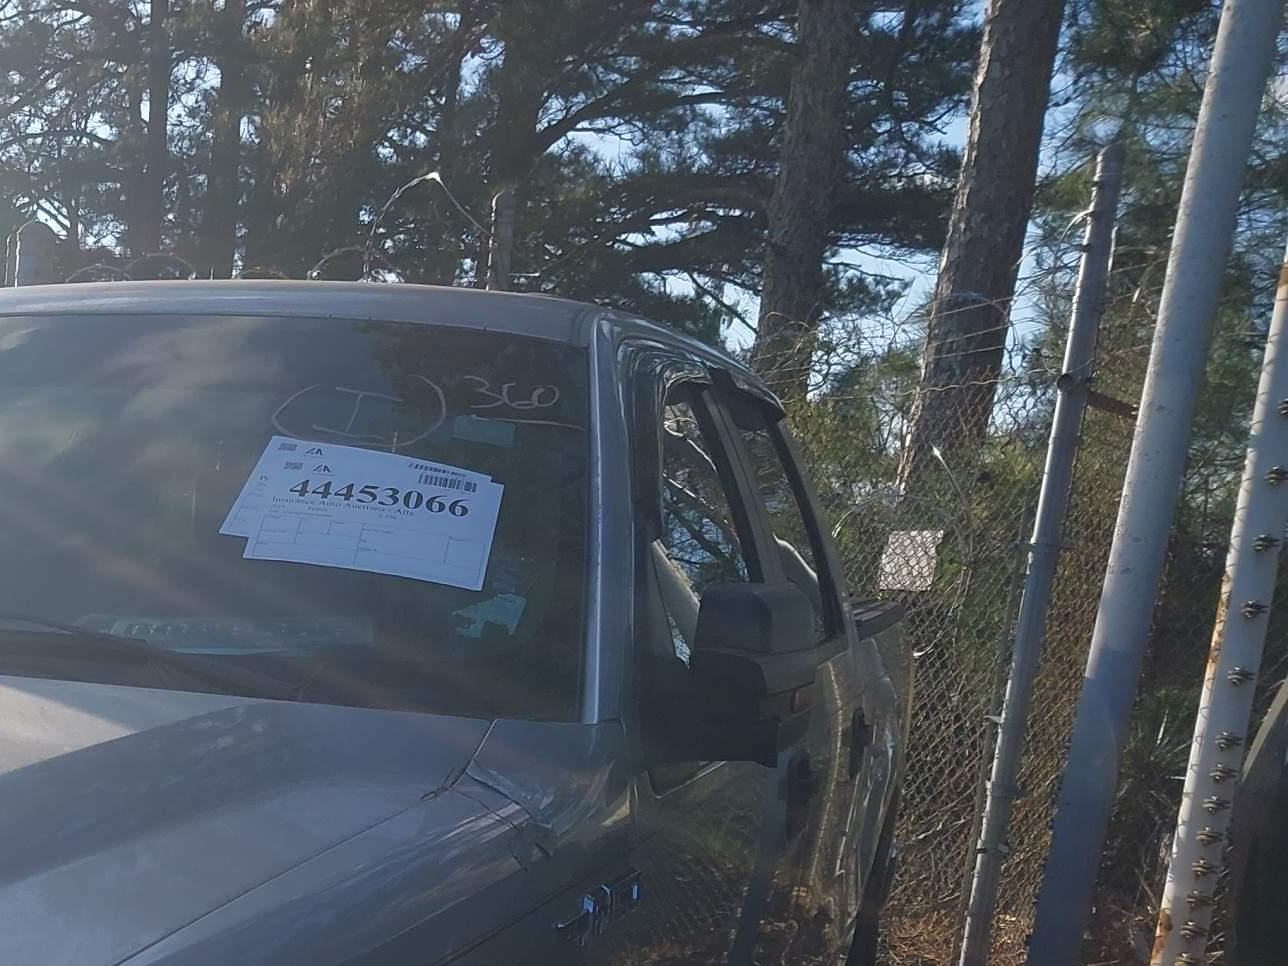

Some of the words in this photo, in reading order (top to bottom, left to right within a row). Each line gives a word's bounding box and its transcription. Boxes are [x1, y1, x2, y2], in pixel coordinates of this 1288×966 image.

[463, 374, 560, 409] 360
[271, 496, 314, 505] Insurance
[318, 500, 341, 508] Auto
[288, 479, 470, 518] 44453066
